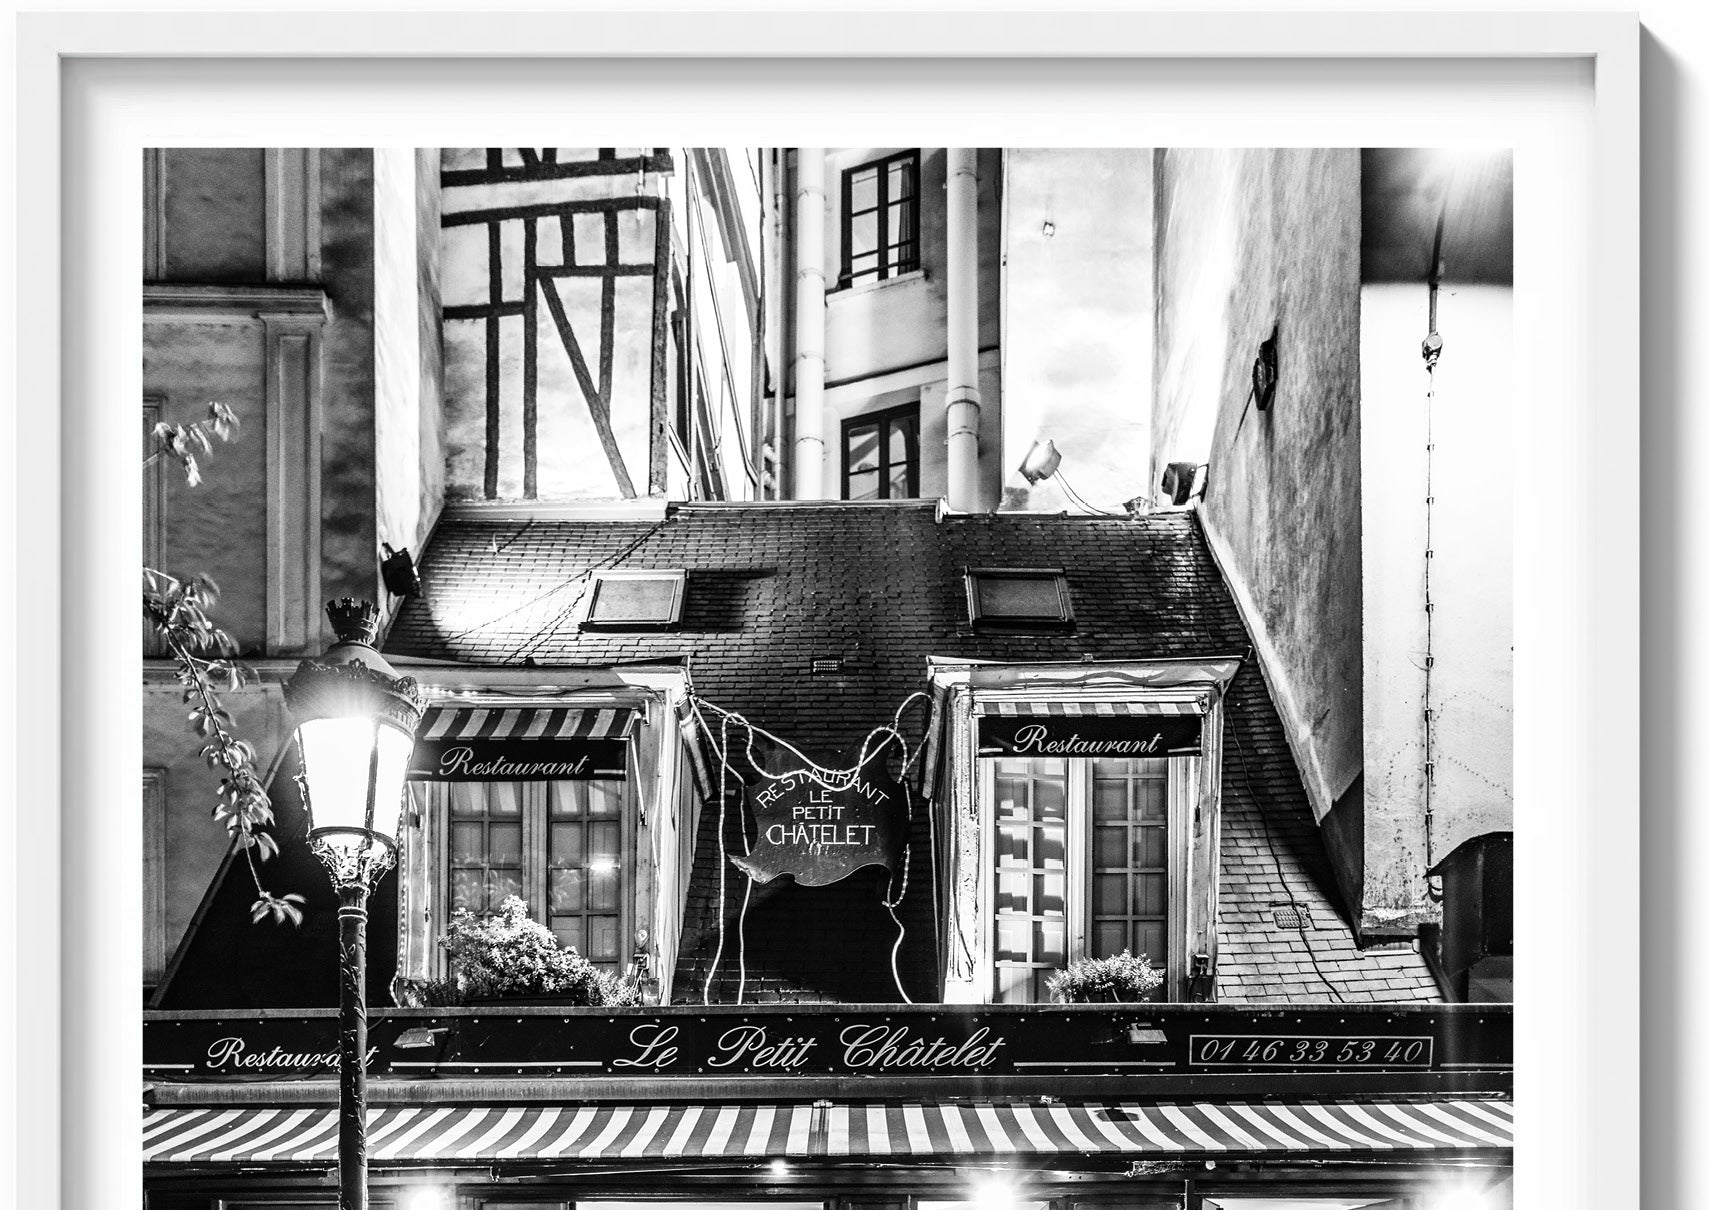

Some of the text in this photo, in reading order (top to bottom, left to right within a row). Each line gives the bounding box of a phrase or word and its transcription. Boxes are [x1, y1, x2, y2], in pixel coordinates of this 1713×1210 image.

[1012, 724, 1163, 753] Restaurant
[438, 746, 590, 776] Restaurant
[756, 768, 890, 809] RESTAURANT
[809, 790, 833, 803] LE
[792, 805, 845, 820] PETIT
[206, 1037, 379, 1068] Restaurat
[613, 1024, 1006, 1067] Le Petit Châtelet
[1200, 1039, 1423, 1062] 01 46 33 53 40
